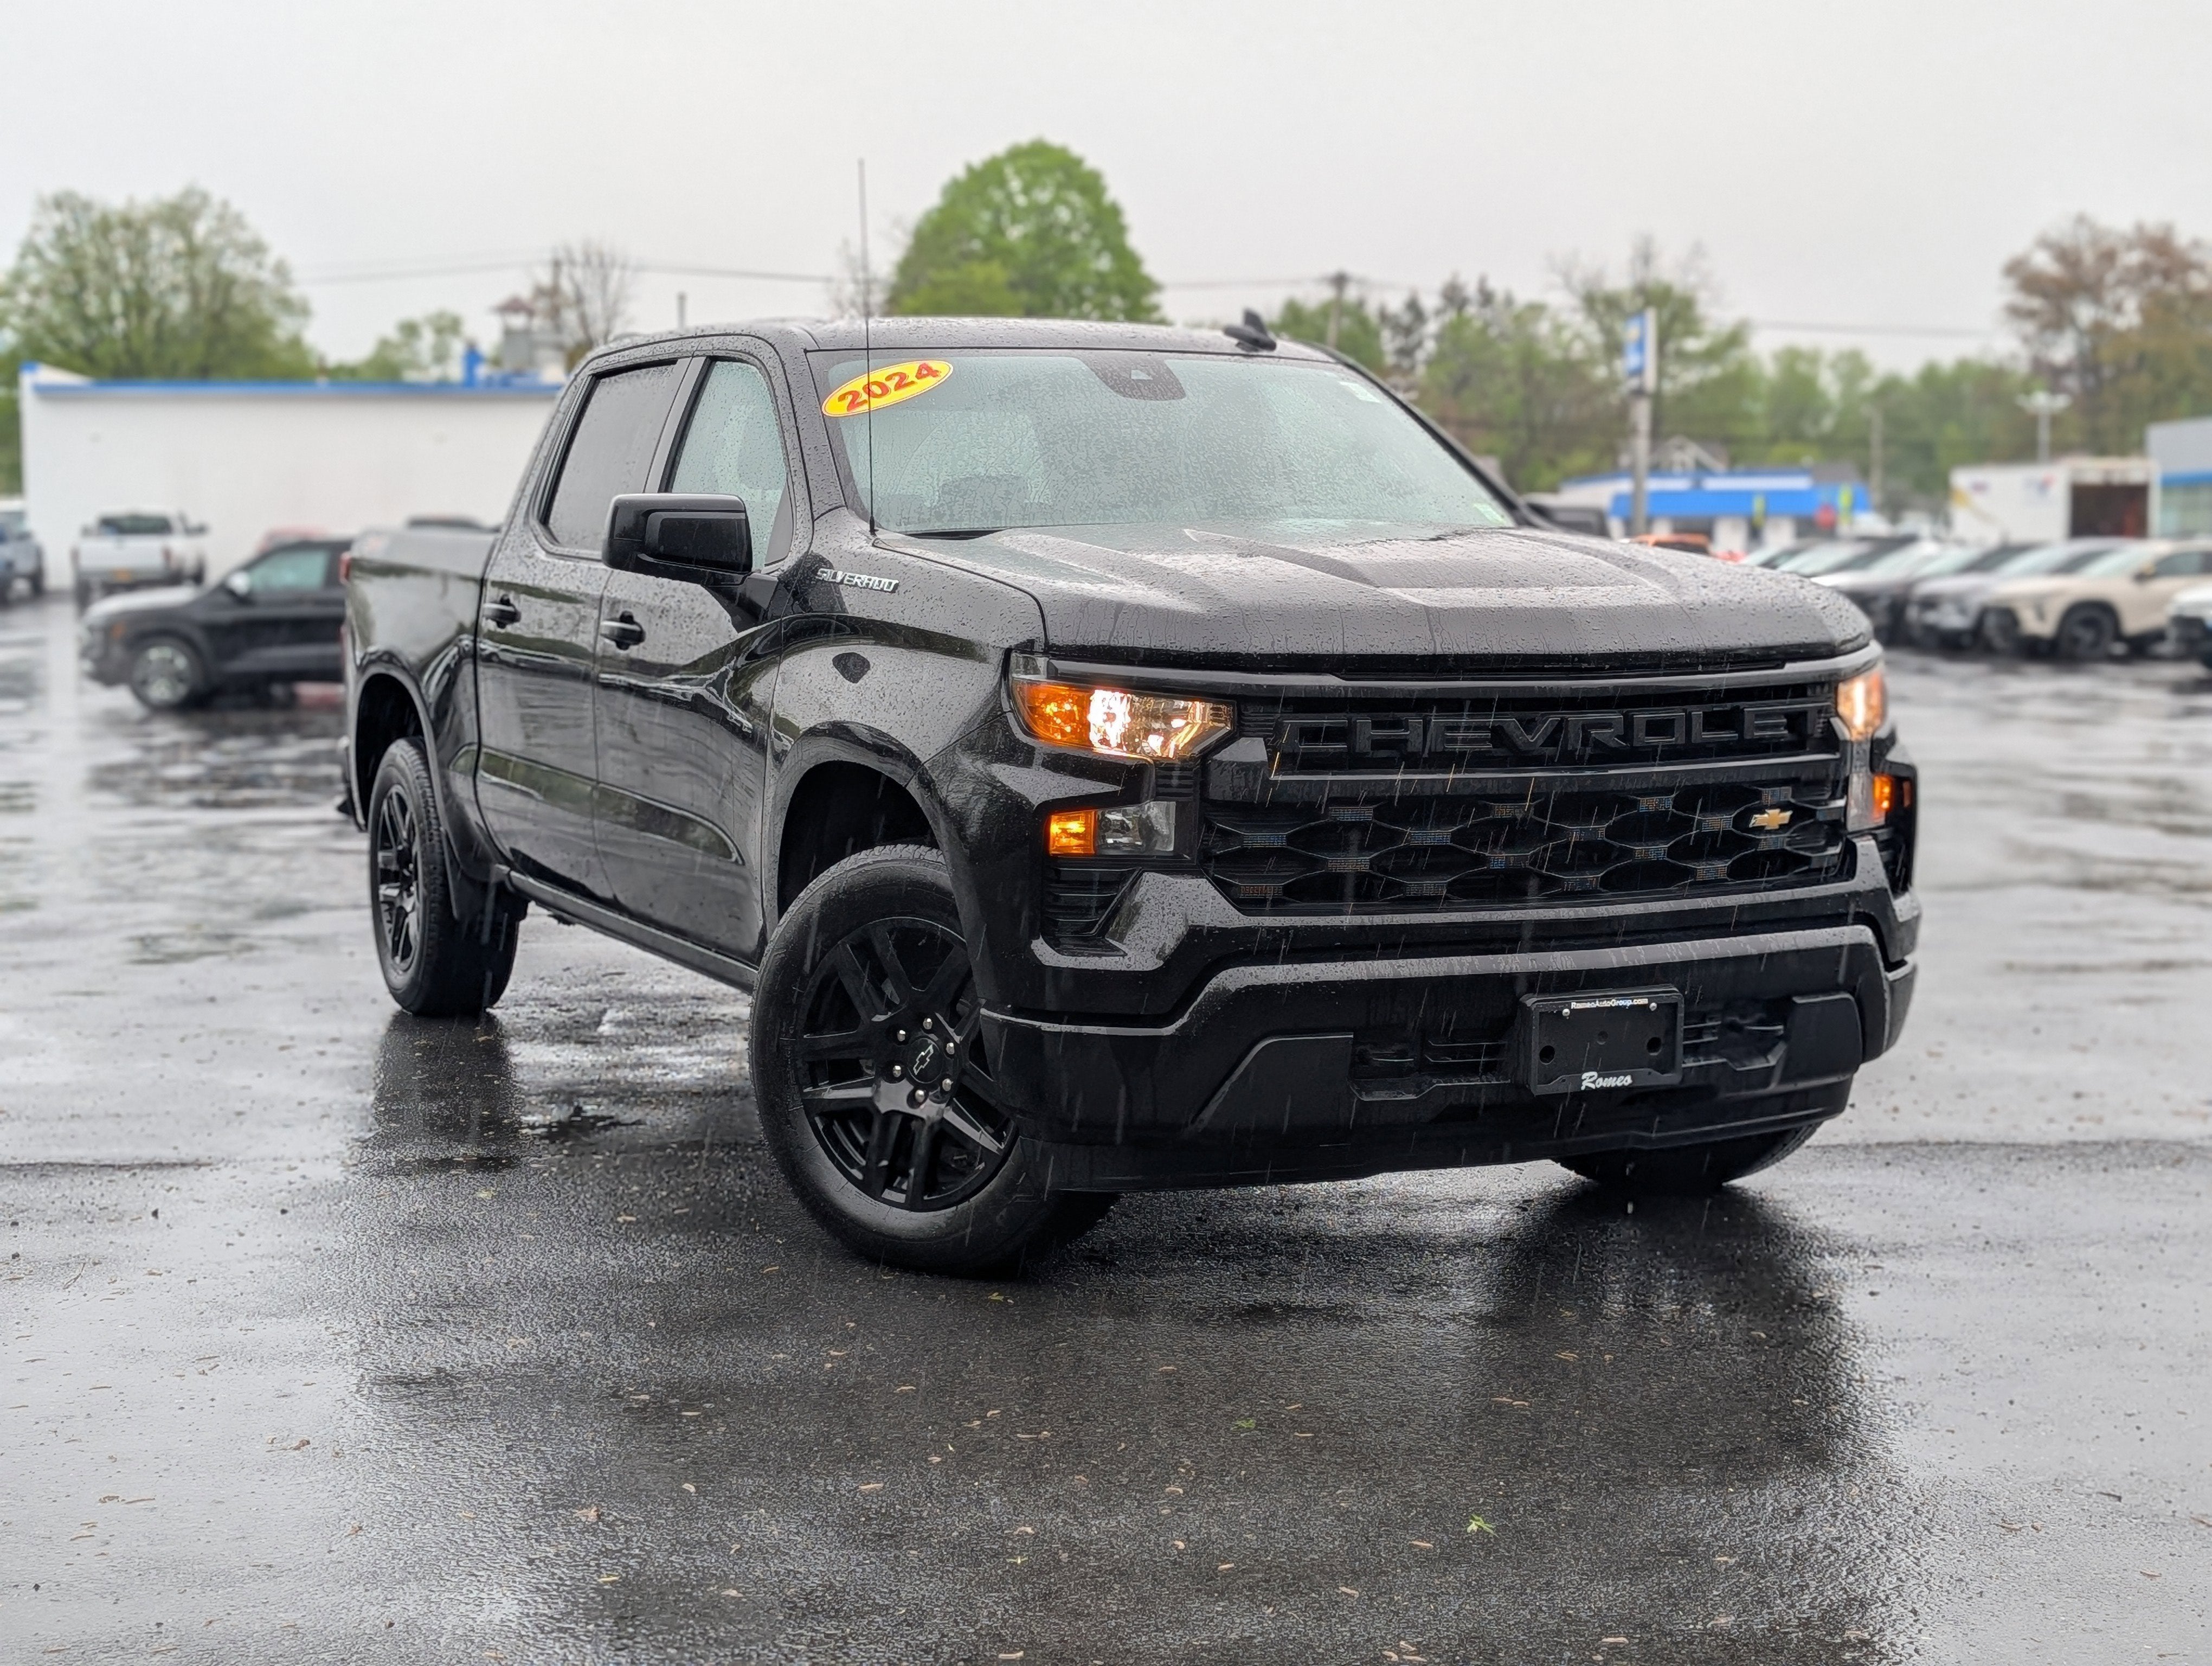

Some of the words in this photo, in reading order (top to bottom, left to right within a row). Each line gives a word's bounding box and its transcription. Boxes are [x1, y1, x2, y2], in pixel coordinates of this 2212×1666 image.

[838, 362, 941, 412] 2024
[815, 568, 899, 592] SILVERADO
[1580, 1071, 1633, 1091] Romeo
